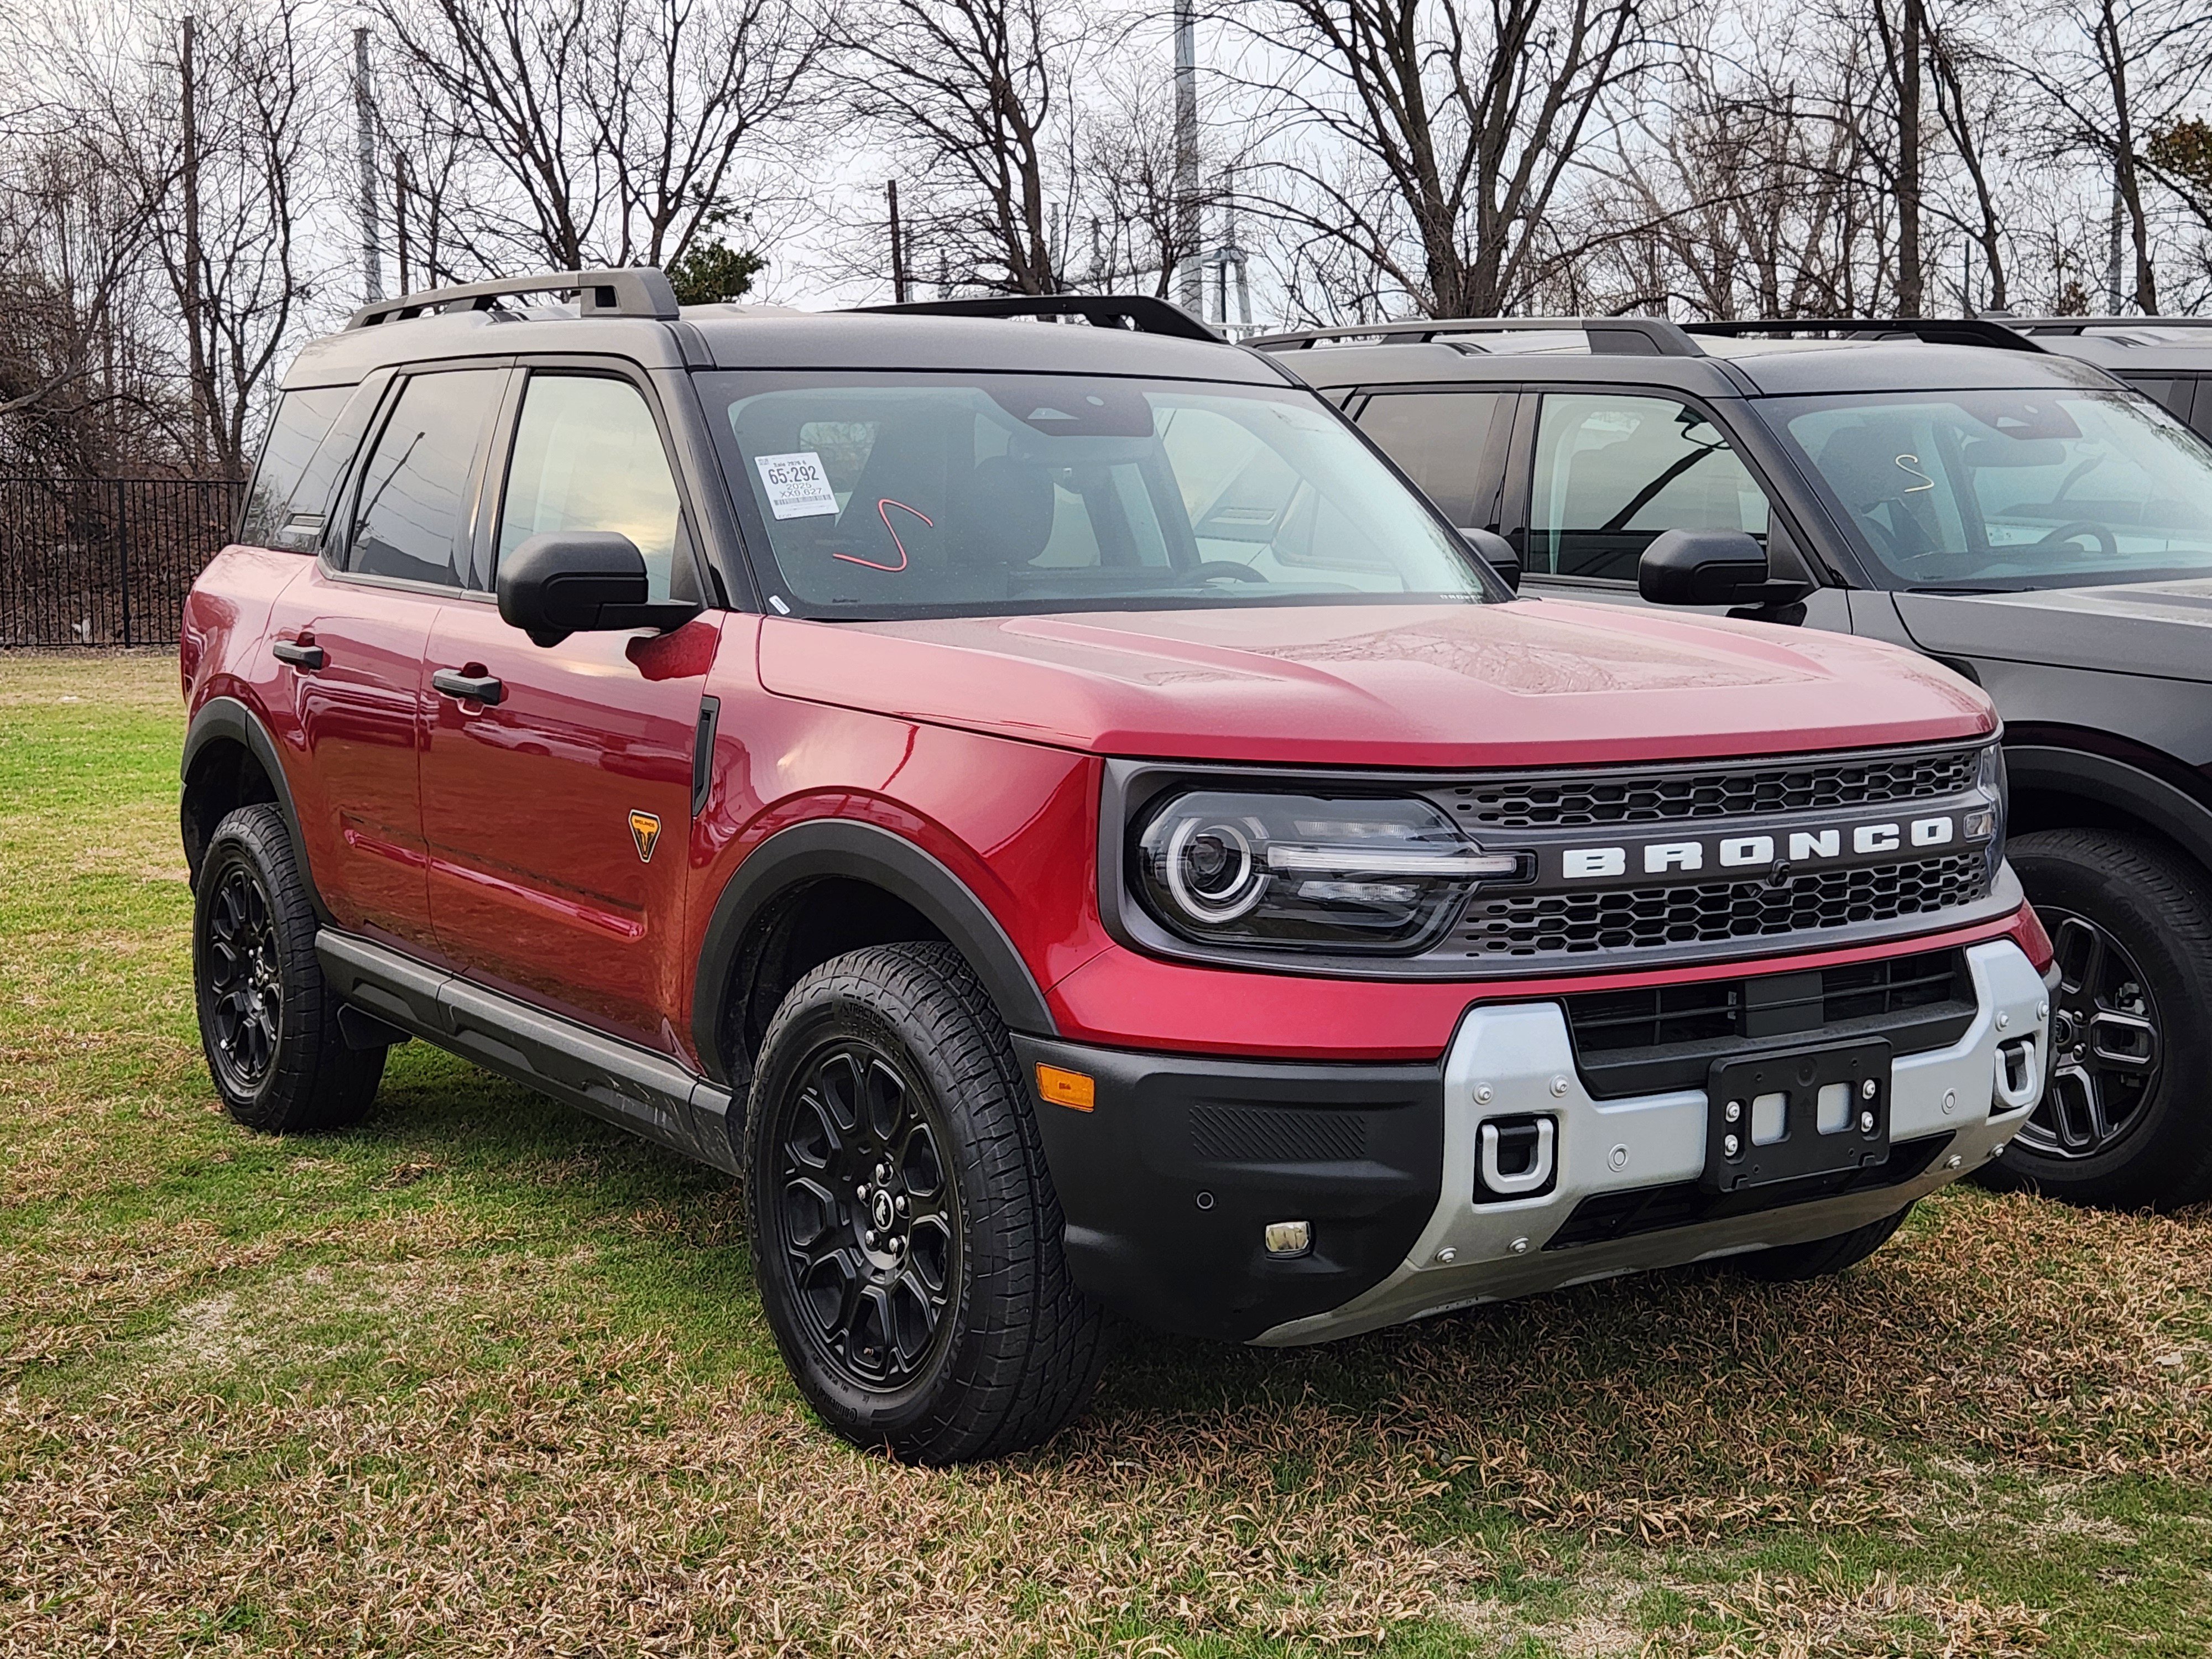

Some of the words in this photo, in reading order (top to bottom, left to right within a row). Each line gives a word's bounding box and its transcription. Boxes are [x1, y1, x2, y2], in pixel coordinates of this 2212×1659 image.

[768, 466, 819, 484] 65:292
[1563, 816, 1952, 878] BRONCO
[849, 1002, 885, 1028] TRACTION
